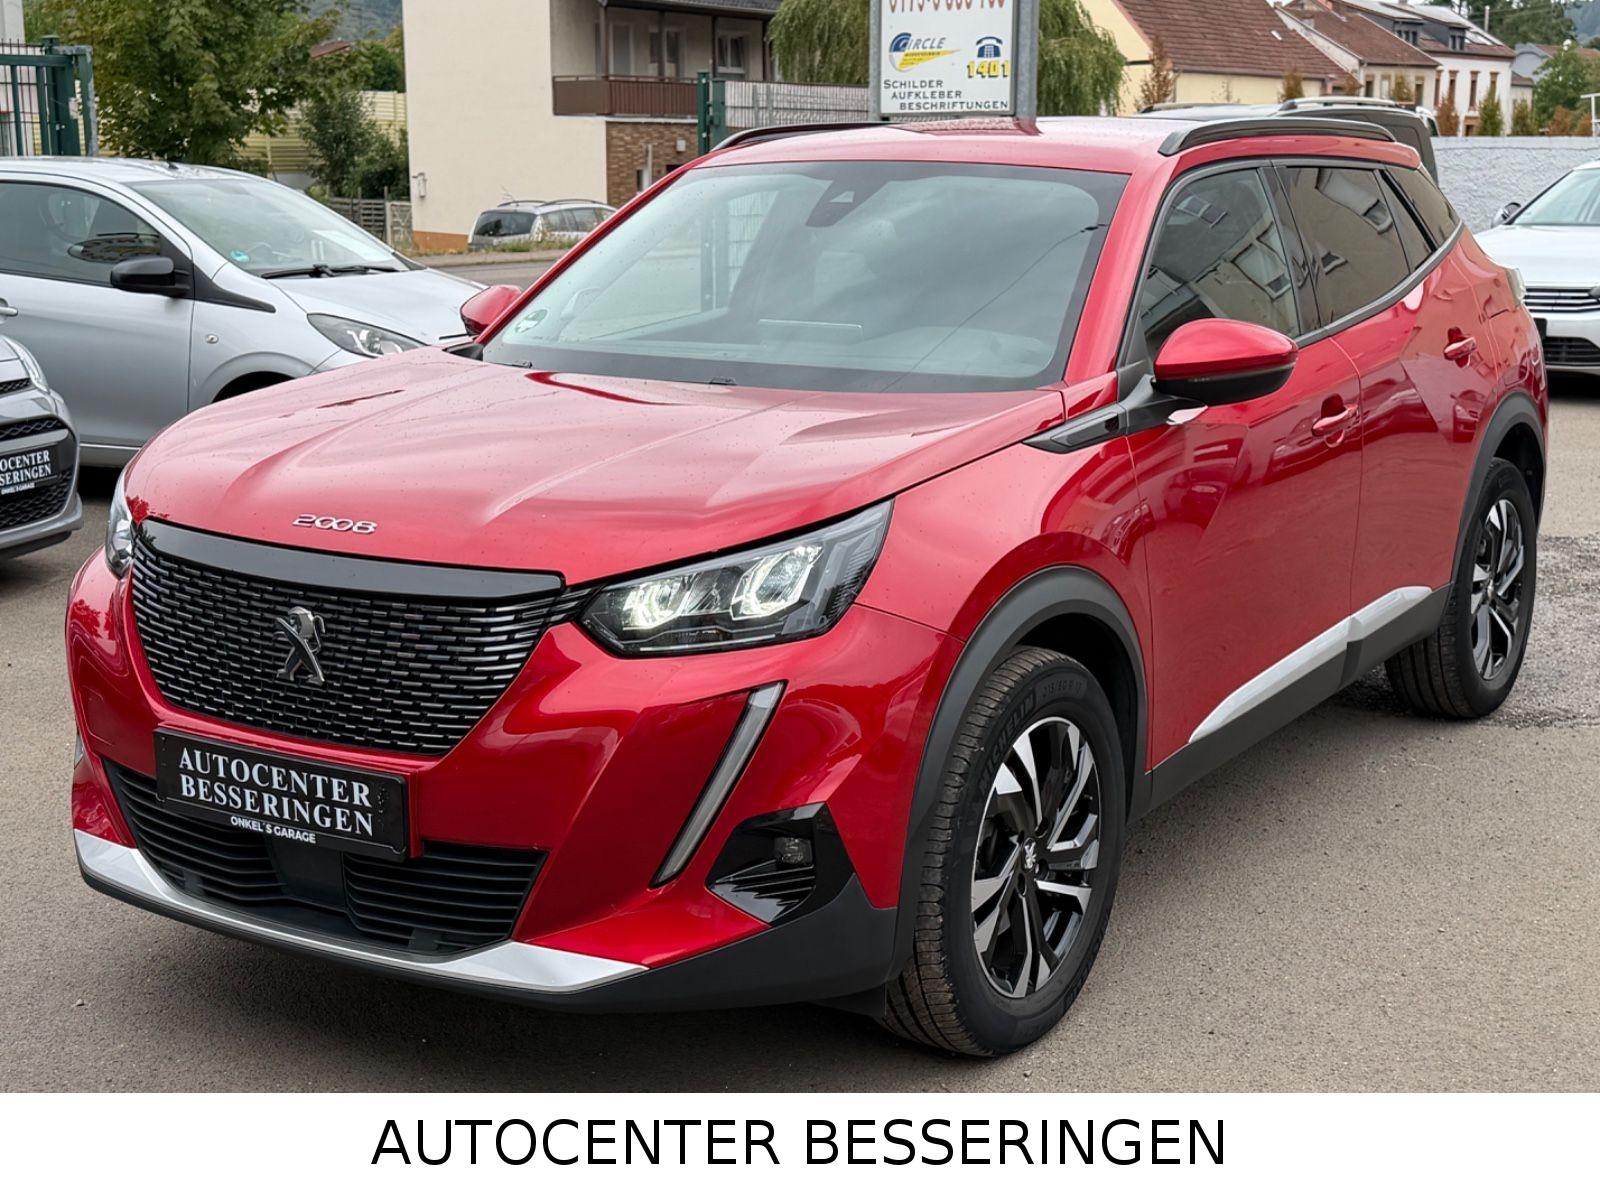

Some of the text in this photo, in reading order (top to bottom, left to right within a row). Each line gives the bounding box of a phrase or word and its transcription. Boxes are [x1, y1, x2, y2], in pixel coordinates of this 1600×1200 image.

[883, 79, 943, 90] SCHILDER
[891, 90, 962, 100] AUFKLEBER
[899, 100, 1008, 111] BESCHRIFTUNGEN
[292, 513, 378, 534] 2008
[178, 747, 373, 808] AUTOCENTER
[179, 773, 374, 837] BESSERINGEN
[273, 825, 317, 845] GARAGE
